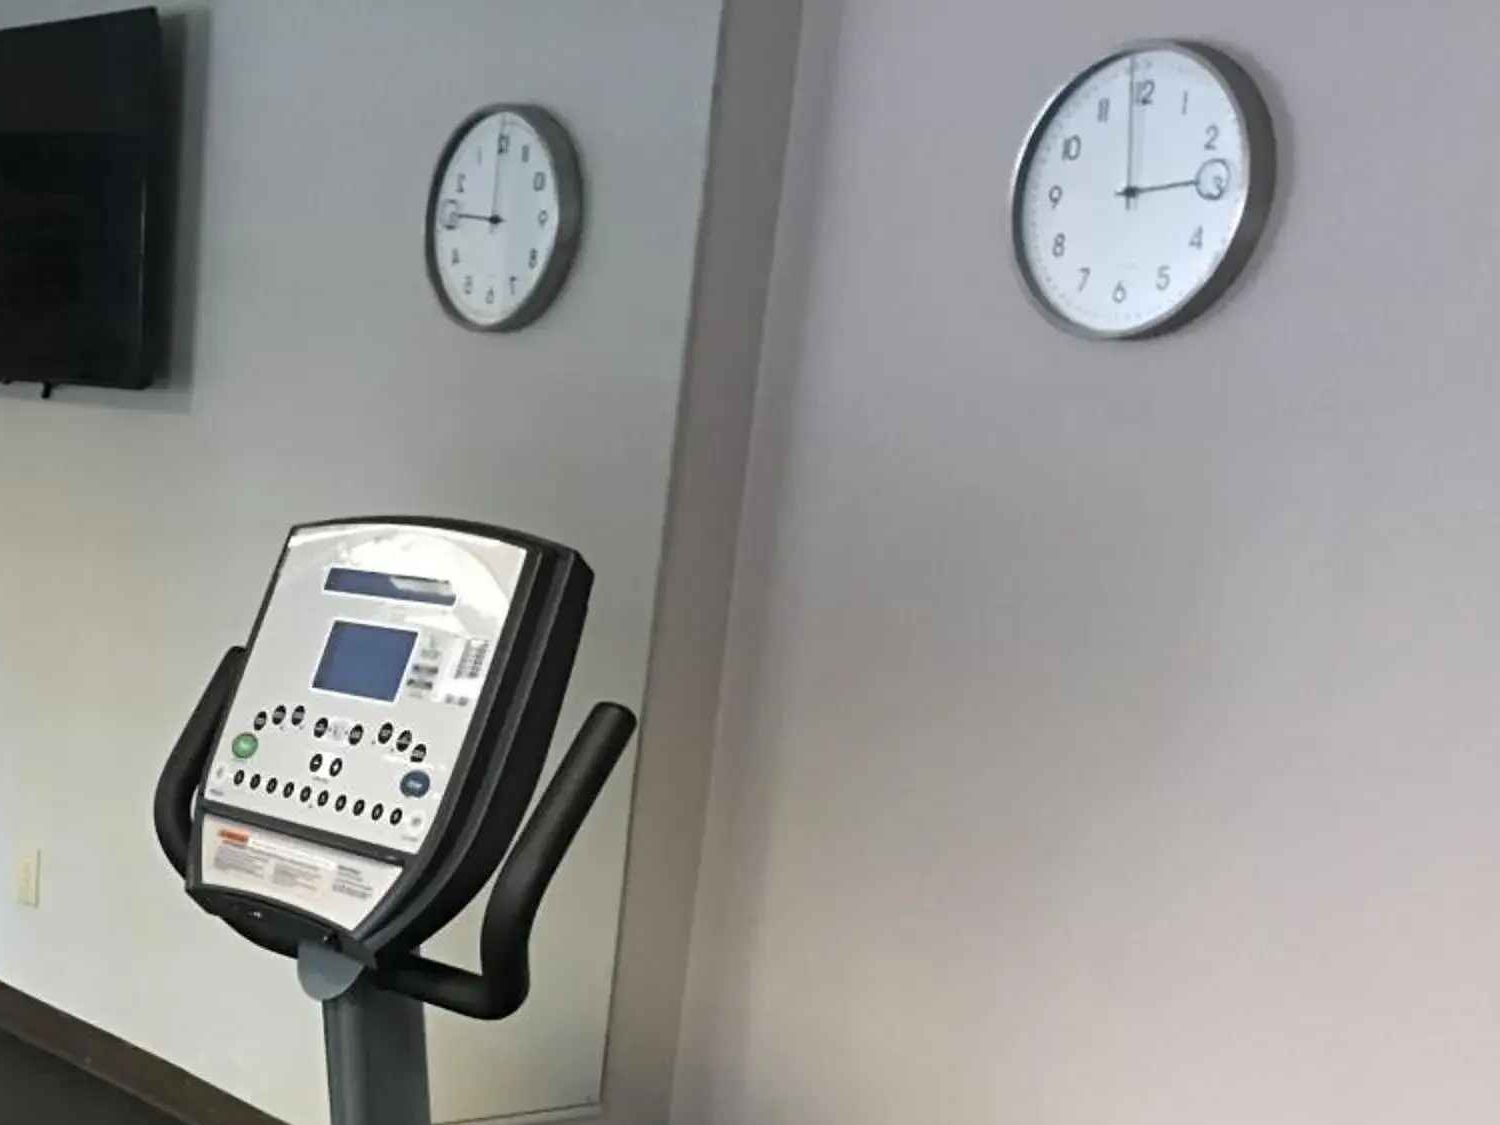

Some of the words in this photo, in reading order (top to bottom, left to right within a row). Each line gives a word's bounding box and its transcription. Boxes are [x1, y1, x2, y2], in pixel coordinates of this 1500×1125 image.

[1097, 98, 1109, 122] 11
[1181, 90, 1188, 115] 1
[1062, 134, 1081, 162] 10
[1204, 124, 1219, 149] 2
[1049, 184, 1063, 210] 9
[1052, 231, 1066, 258] 8
[1188, 225, 1204, 251] 4
[1077, 267, 1091, 293] 7
[1155, 265, 1171, 291] 5
[1110, 279, 1128, 304] 6
